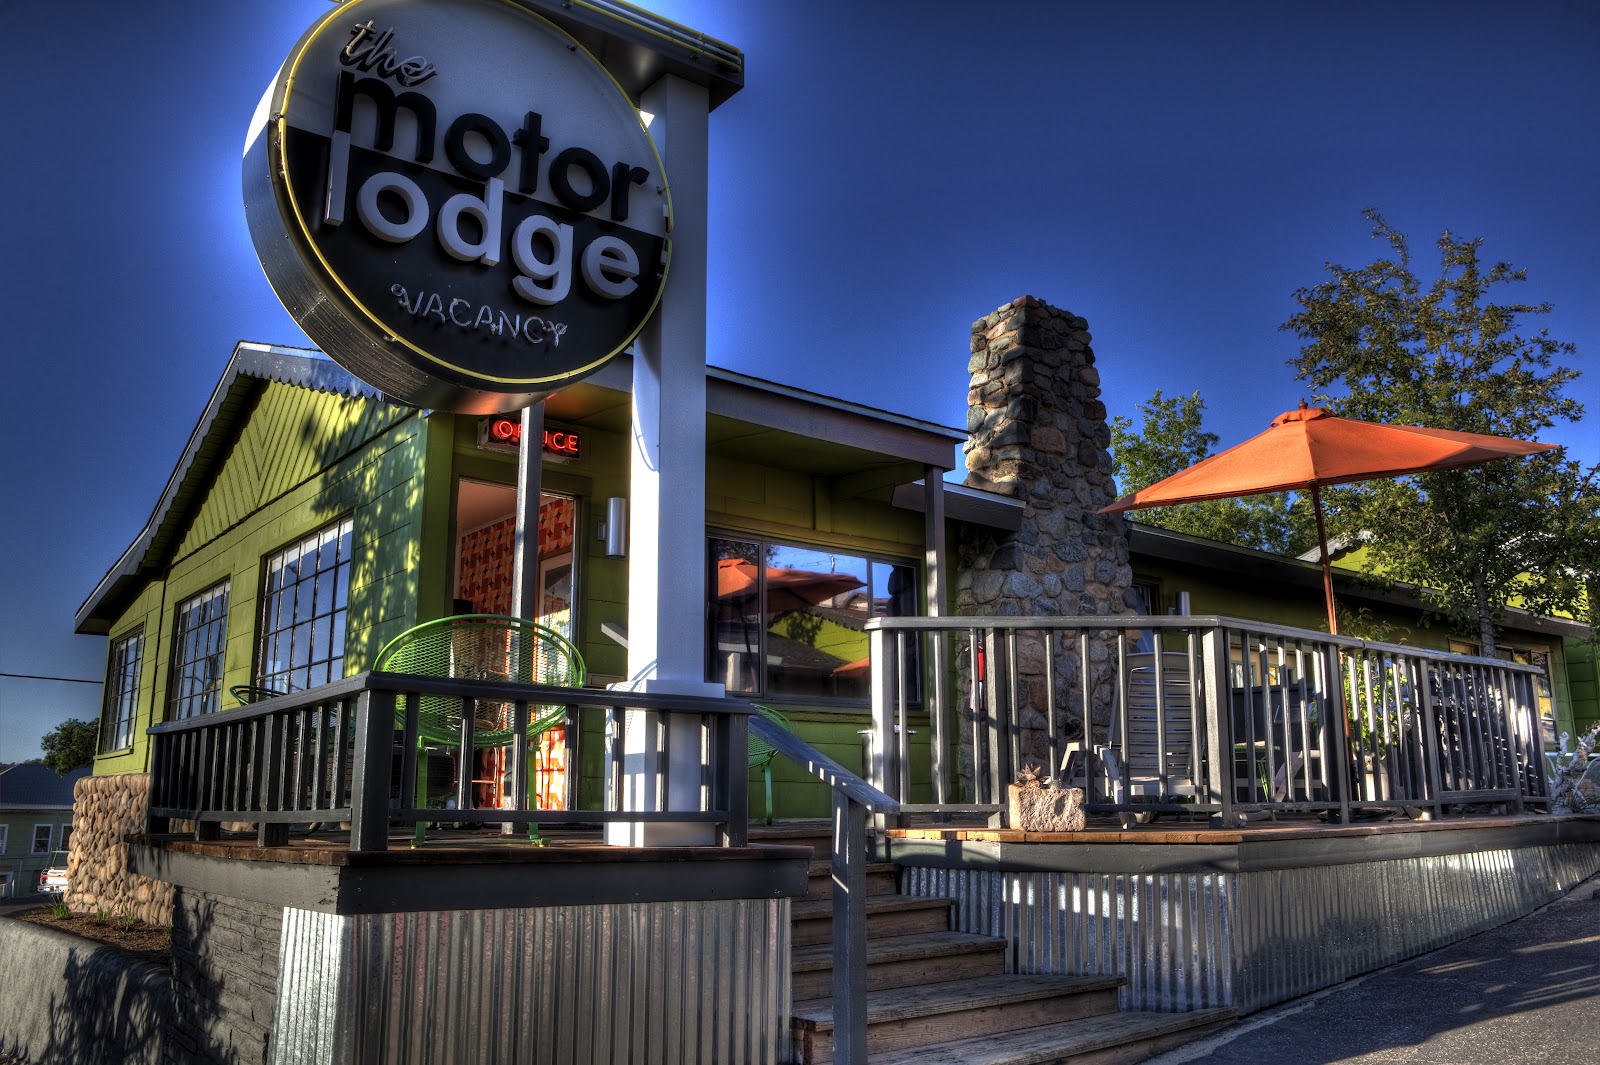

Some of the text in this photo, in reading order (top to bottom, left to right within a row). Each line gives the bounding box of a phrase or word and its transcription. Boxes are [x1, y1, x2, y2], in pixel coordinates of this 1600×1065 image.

[340, 20, 437, 87] the
[335, 70, 650, 222] motor
[324, 131, 641, 306] lodge
[391, 283, 568, 348] VACANCY
[498, 420, 578, 452] OFICE
